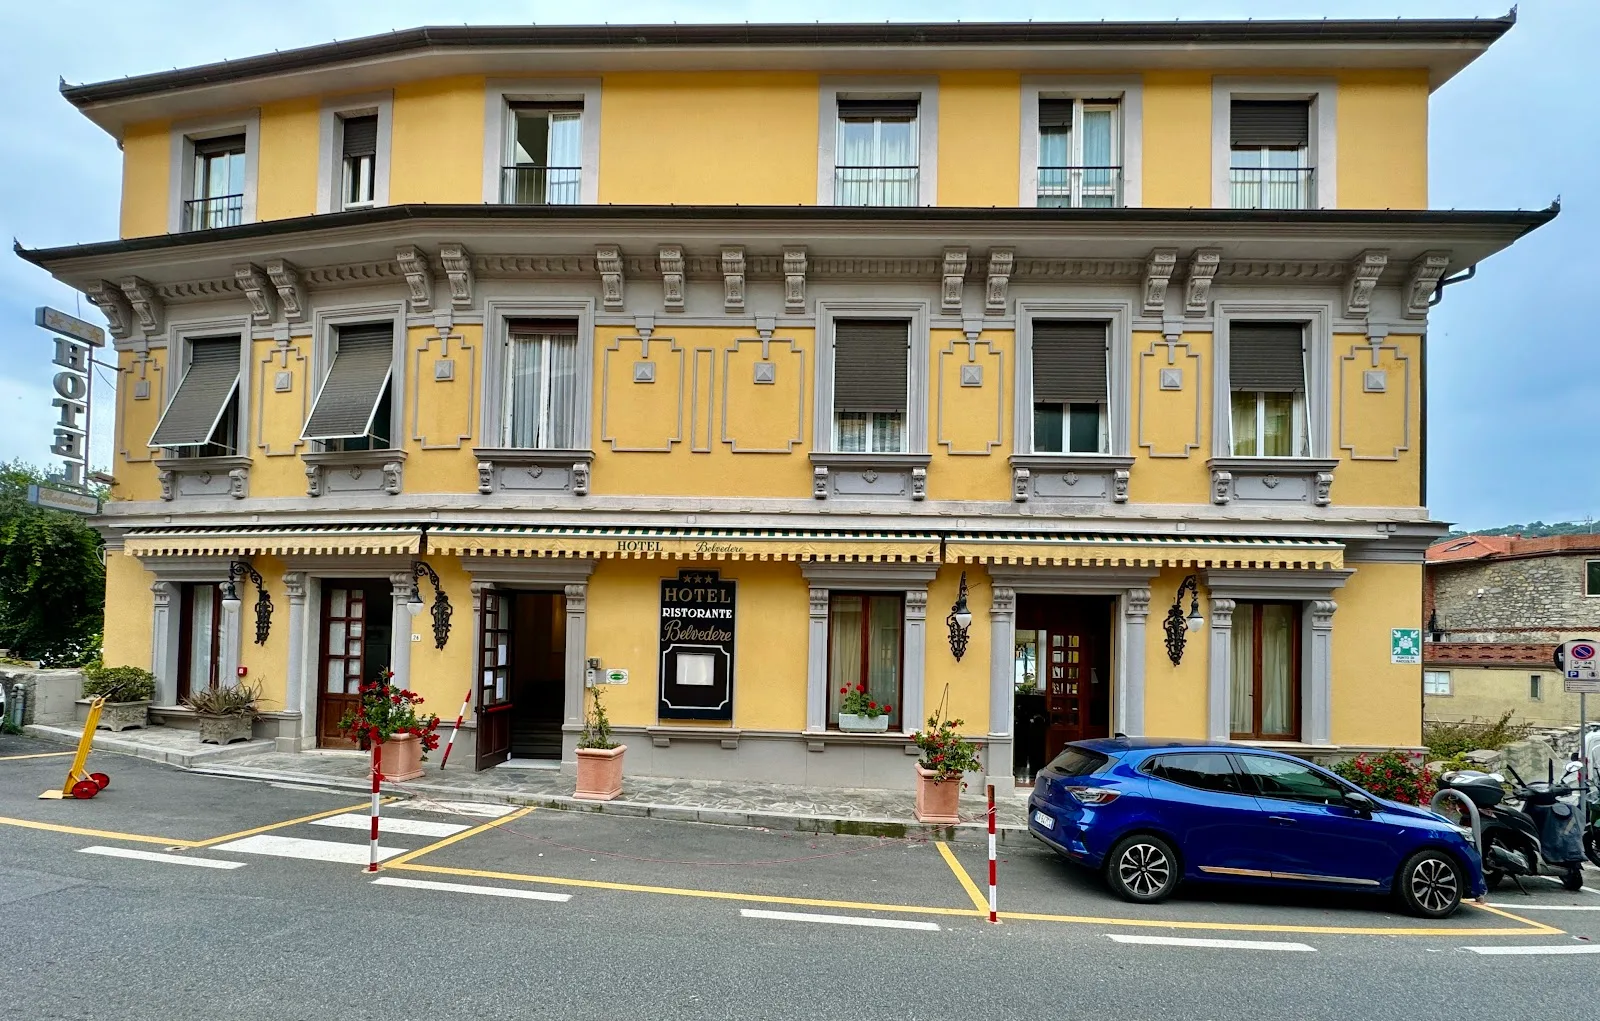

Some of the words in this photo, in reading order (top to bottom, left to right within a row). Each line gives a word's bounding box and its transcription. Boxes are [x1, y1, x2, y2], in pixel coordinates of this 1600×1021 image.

[617, 541, 664, 551] HOTEL
[693, 541, 744, 552] Belvedere
[664, 587, 731, 603] HOTEL
[662, 607, 733, 619] RISTORANTE
[661, 619, 732, 641] Belvedere
